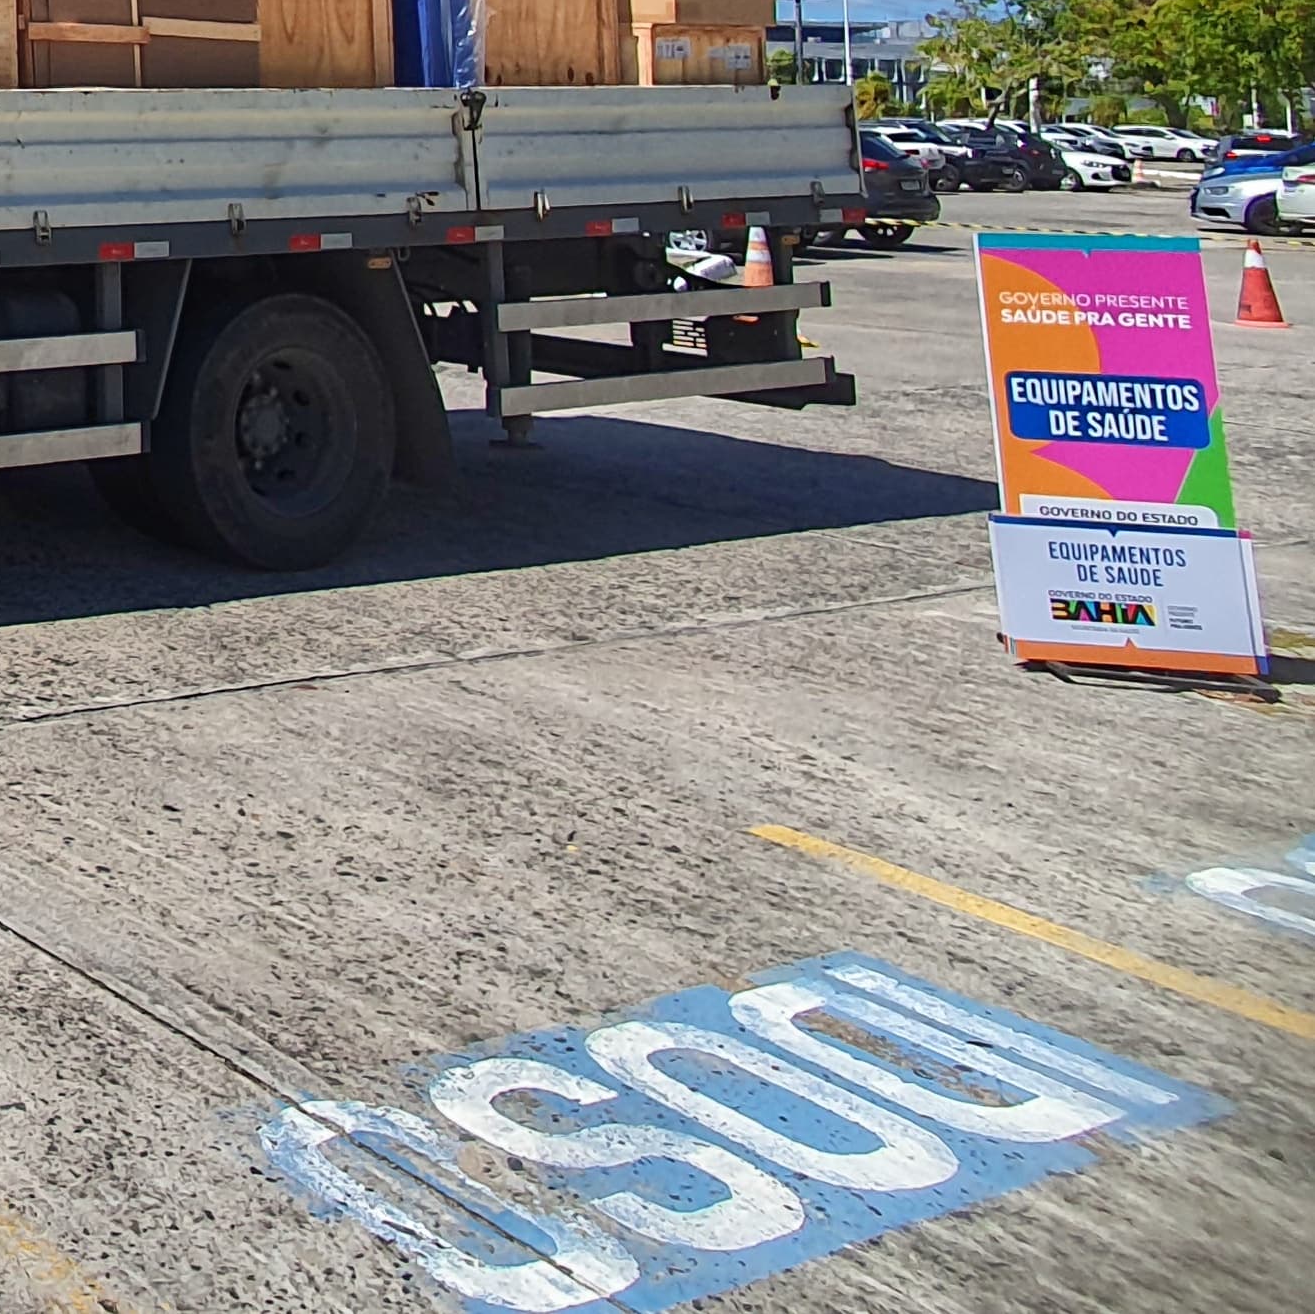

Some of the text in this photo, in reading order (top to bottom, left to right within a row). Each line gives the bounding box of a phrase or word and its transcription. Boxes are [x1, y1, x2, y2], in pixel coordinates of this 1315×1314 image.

[999, 291, 1189, 310] GOVERNO PRESENTE
[1000, 305, 1192, 329] SAÚDE PRA GENTE
[1010, 377, 1200, 411] EQUIPAMENTOS
[1048, 408, 1169, 441] DE SAÚDE
[1039, 505, 1198, 526] GOVERNO DO ESTADO
[1048, 541, 1187, 567] EQUIPAMENTOS
[1077, 564, 1164, 587] DE SAUDE
[1048, 589, 1153, 604] GOVERNO DO ESTADO
[1050, 598, 1157, 627] BAHIA
